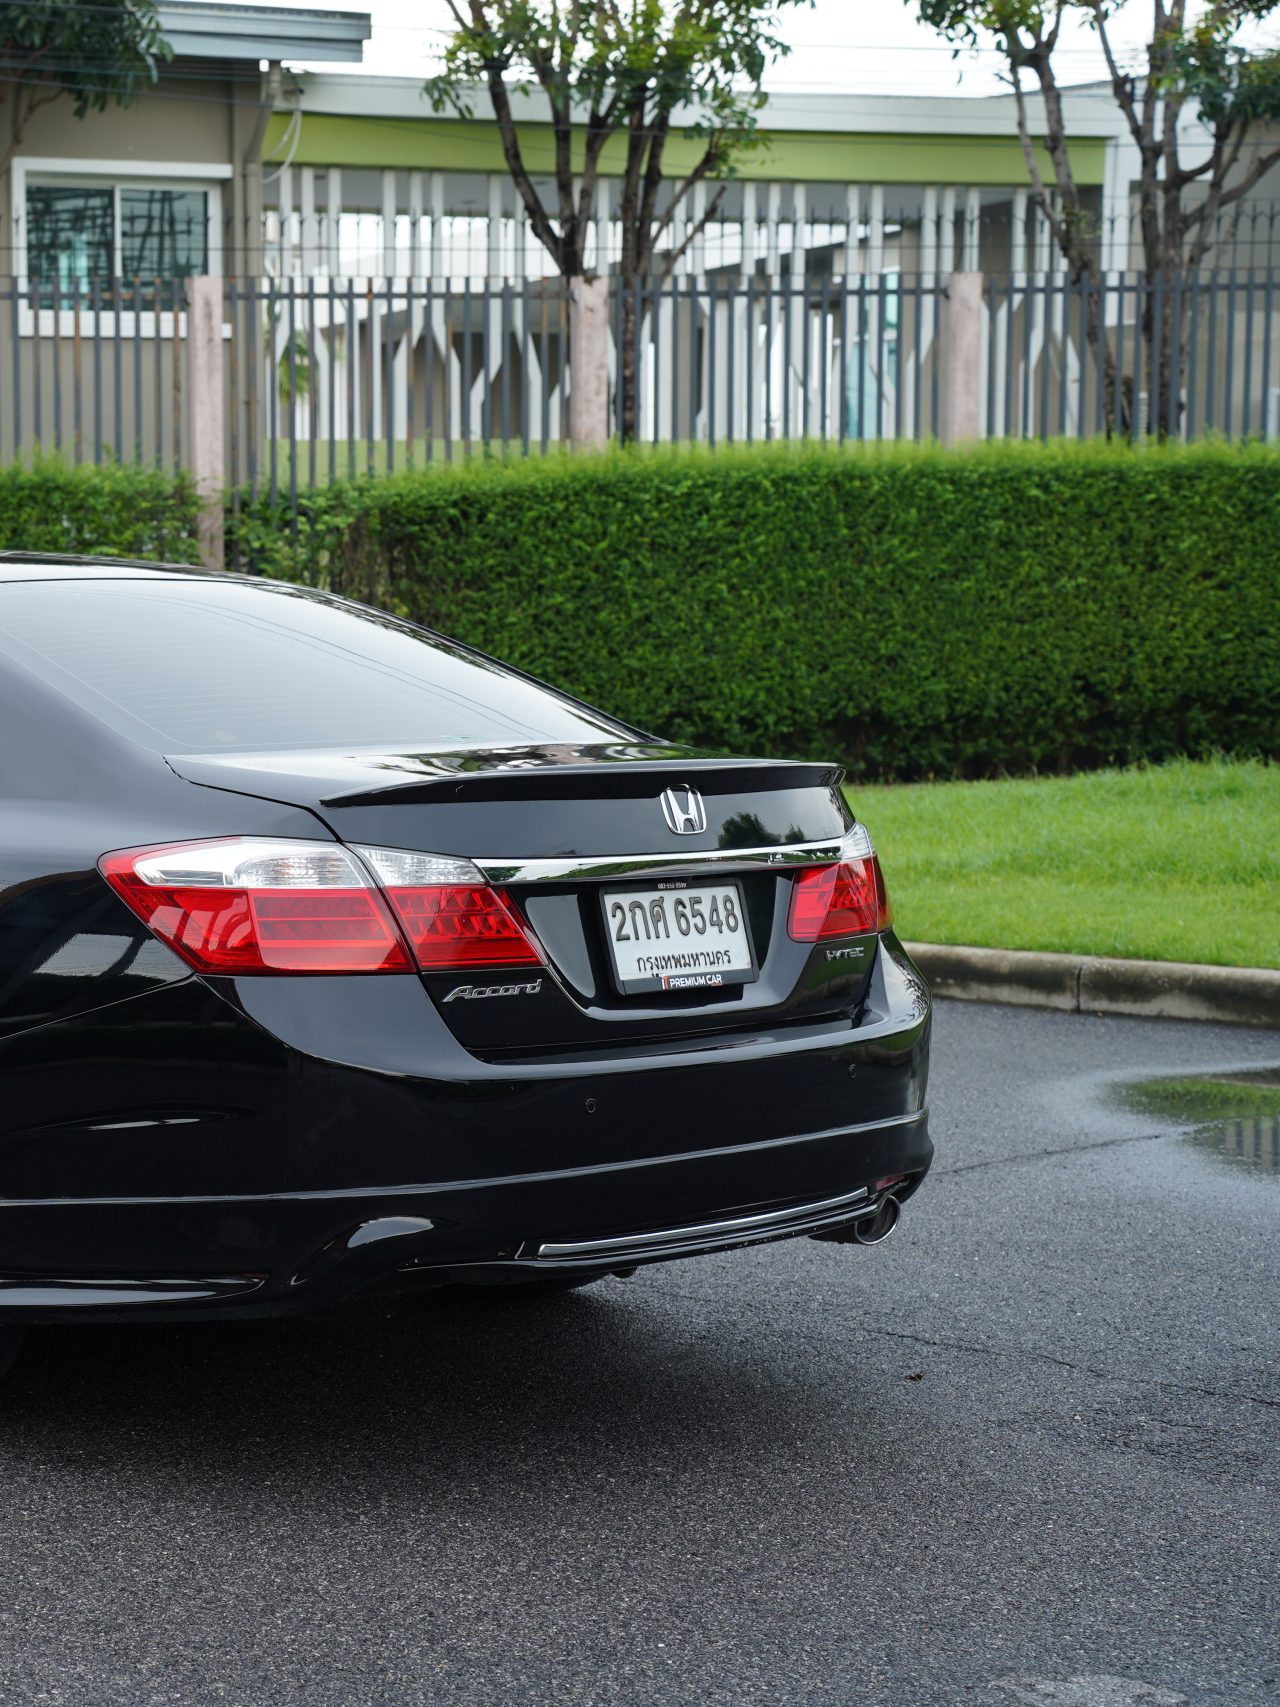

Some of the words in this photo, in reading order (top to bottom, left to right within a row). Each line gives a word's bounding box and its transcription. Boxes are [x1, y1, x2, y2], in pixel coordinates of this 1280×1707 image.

[611, 896, 670, 941] 2กศ
[673, 894, 739, 936] 6548
[442, 979, 542, 1002] Accord
[669, 975, 706, 988] PREMIUM
[706, 973, 723, 985] CAR
